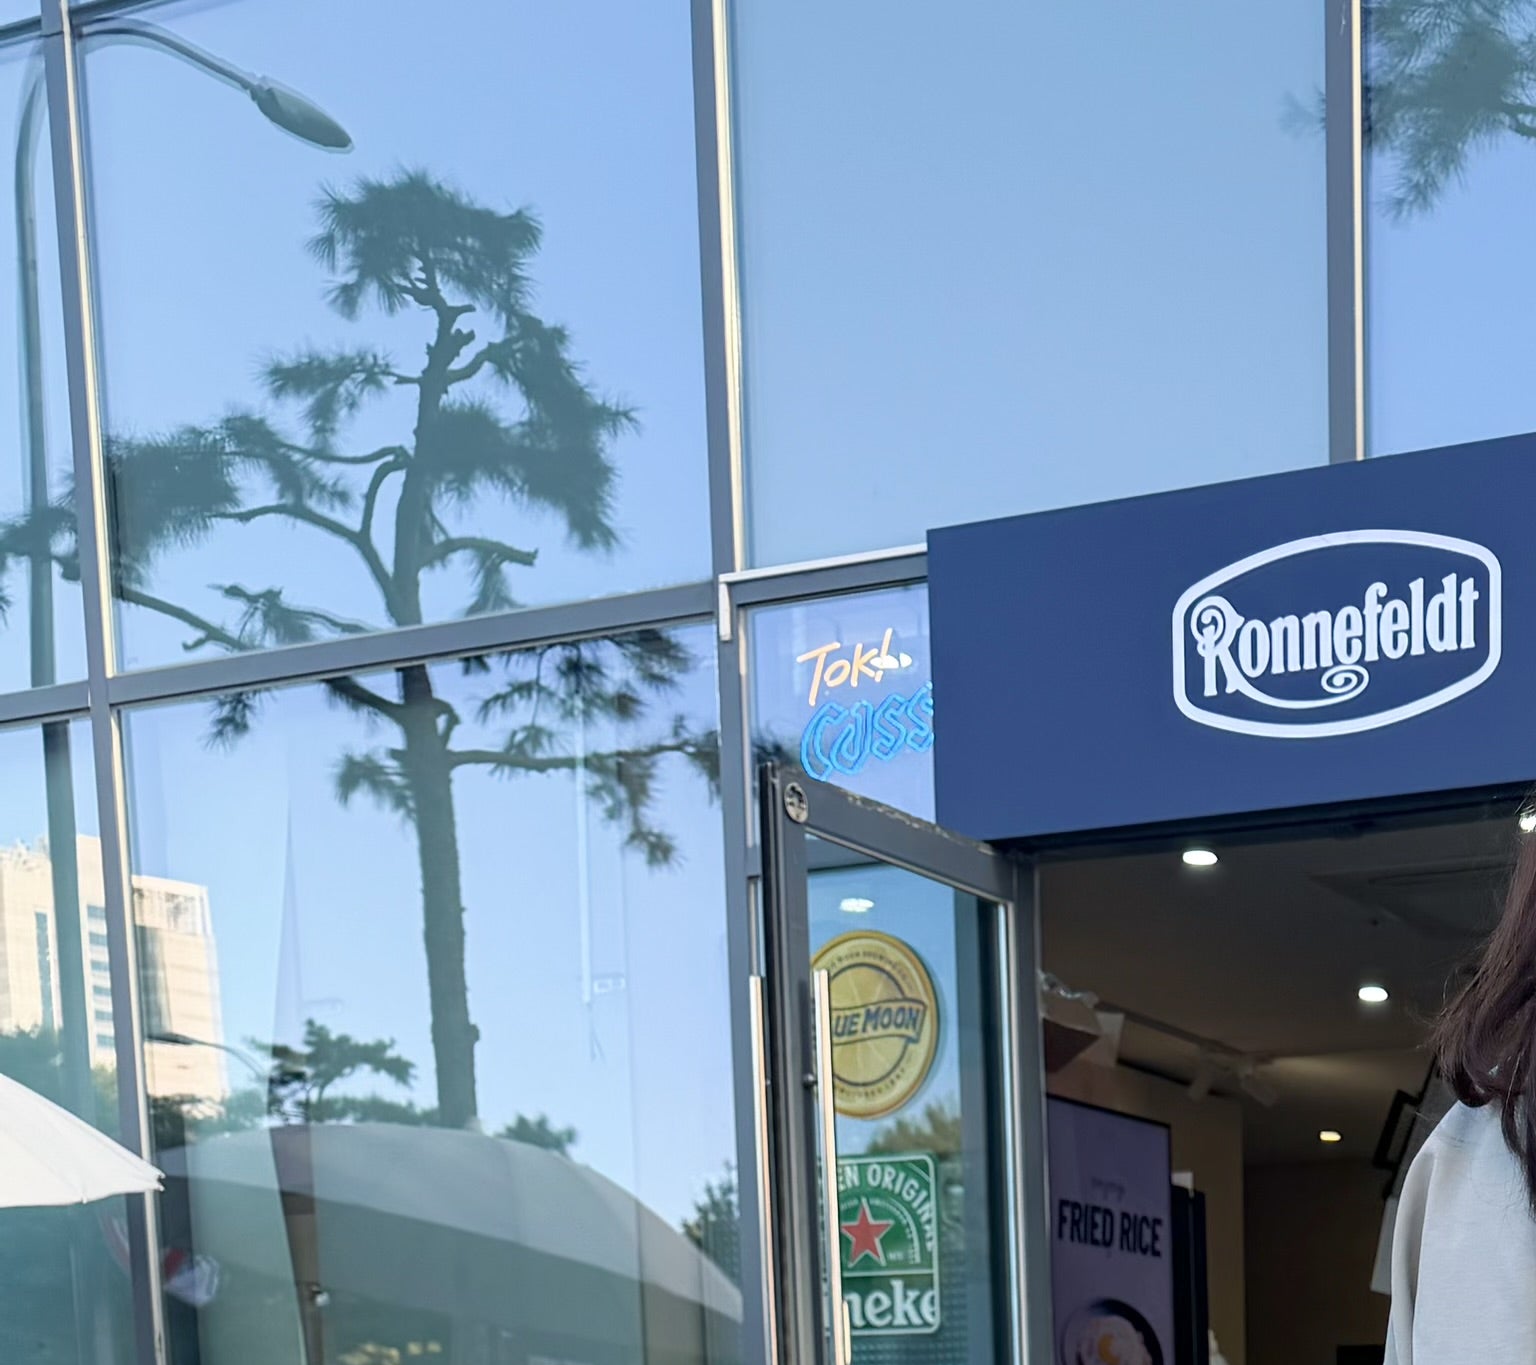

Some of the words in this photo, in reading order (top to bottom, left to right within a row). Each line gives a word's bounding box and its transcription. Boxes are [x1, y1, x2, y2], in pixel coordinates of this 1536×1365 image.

[1191, 572, 1479, 709] Ronnefeldt
[834, 1013, 861, 1038] UE
[862, 1005, 921, 1034] MOON
[1058, 1198, 1114, 1248] FRIED
[1120, 1211, 1162, 1258] RICE
